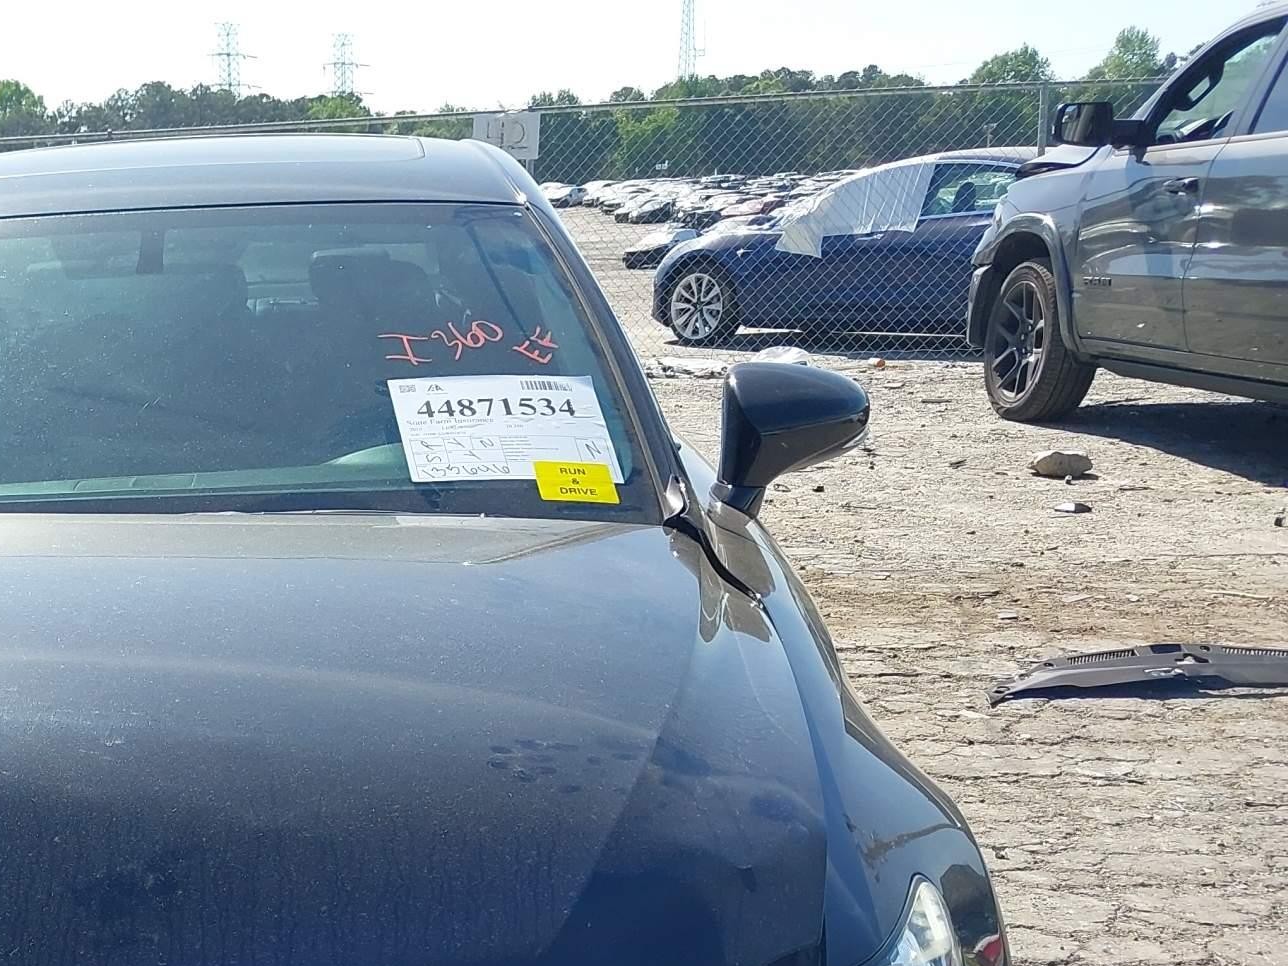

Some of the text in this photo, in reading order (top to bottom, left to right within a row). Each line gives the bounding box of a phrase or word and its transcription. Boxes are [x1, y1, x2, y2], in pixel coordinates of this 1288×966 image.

[417, 397, 575, 418] 44871534
[559, 467, 586, 475] RUN
[559, 487, 598, 496] DRIVE
